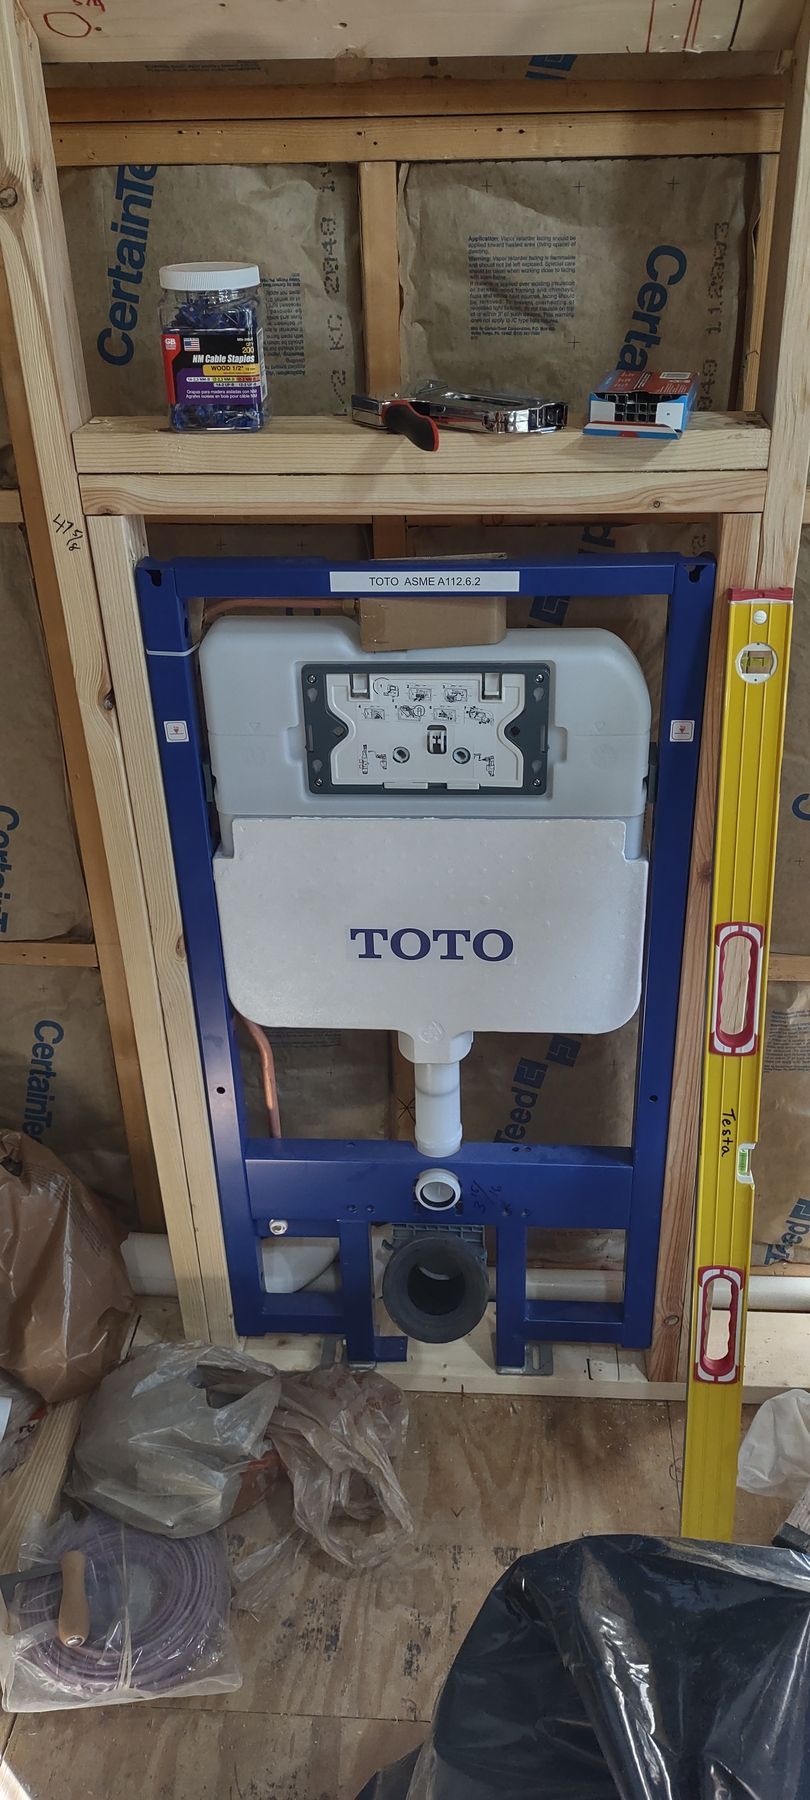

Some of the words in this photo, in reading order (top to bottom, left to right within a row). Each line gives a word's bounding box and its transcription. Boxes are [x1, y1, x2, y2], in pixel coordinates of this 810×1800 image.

[192, 354, 204, 363] NM
[205, 354, 226, 363] Cable
[227, 354, 255, 364] Staples
[369, 577, 399, 587] TOTO
[404, 577, 435, 586] ASME
[437, 577, 481, 586] A112.6.2
[350, 928, 514, 962] TOTO
[721, 1108, 737, 1158] Testa
